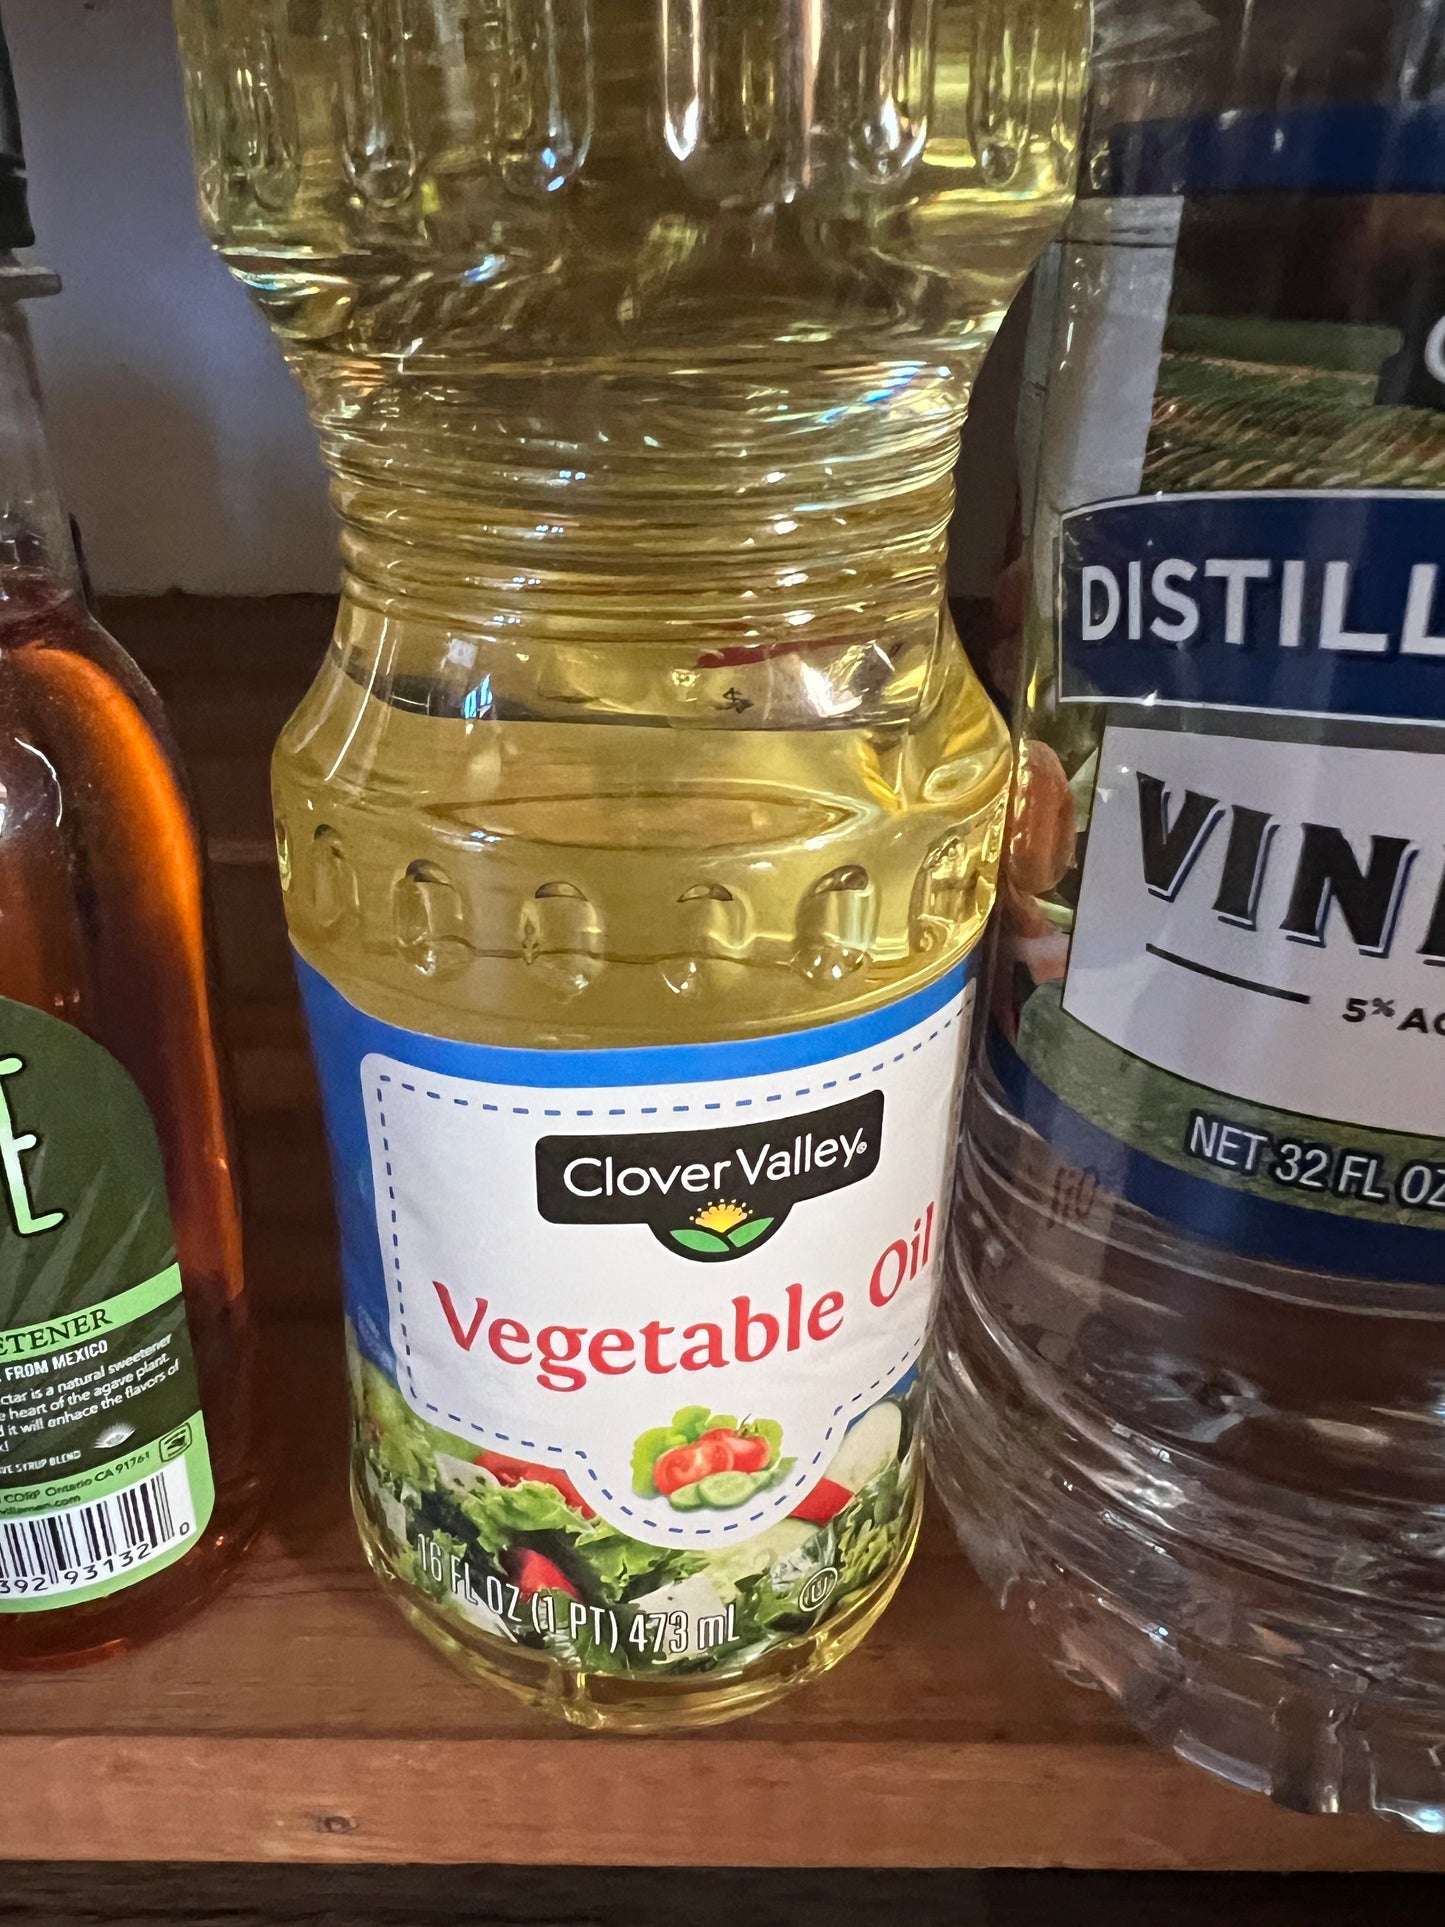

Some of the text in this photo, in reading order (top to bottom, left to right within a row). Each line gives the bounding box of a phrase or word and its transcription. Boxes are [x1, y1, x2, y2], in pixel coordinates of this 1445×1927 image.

[1081, 558, 1445, 656] DISTILL
[1342, 997, 1396, 1023] 5%
[563, 1127, 864, 1196] Clover Valley
[1190, 1116, 1268, 1170] NET
[1275, 1143, 1328, 1187] 32
[1337, 1155, 1386, 1199] FL
[432, 1201, 936, 1392] Vegetable Oil
[4, 1339, 108, 1381] FROM MEXICO
[8, 1403, 48, 1420] heart
[49, 1393, 67, 1411] of
[67, 1391, 91, 1406] the
[93, 1373, 134, 1397] agave
[135, 1353, 171, 1381] plant
[30, 1388, 43, 1399] is
[45, 1386, 55, 1397] a
[57, 1364, 106, 1393] natural
[107, 1333, 173, 1375] sweetener
[7, 1424, 19, 1436] it
[20, 1417, 45, 1433] will
[100, 1394, 123, 1410] the
[125, 1372, 167, 1399] flavors
[167, 1358, 180, 1376] of
[45, 1478, 92, 1497] Ontario
[94, 1468, 115, 1482] CA
[115, 1451, 150, 1474] 91761
[49, 1450, 81, 1466] BLEND
[64, 1543, 151, 1585] 93132
[179, 1521, 190, 1536] 0
[418, 1533, 741, 1654] 16 FL OZ (1 PT) 473 mL
